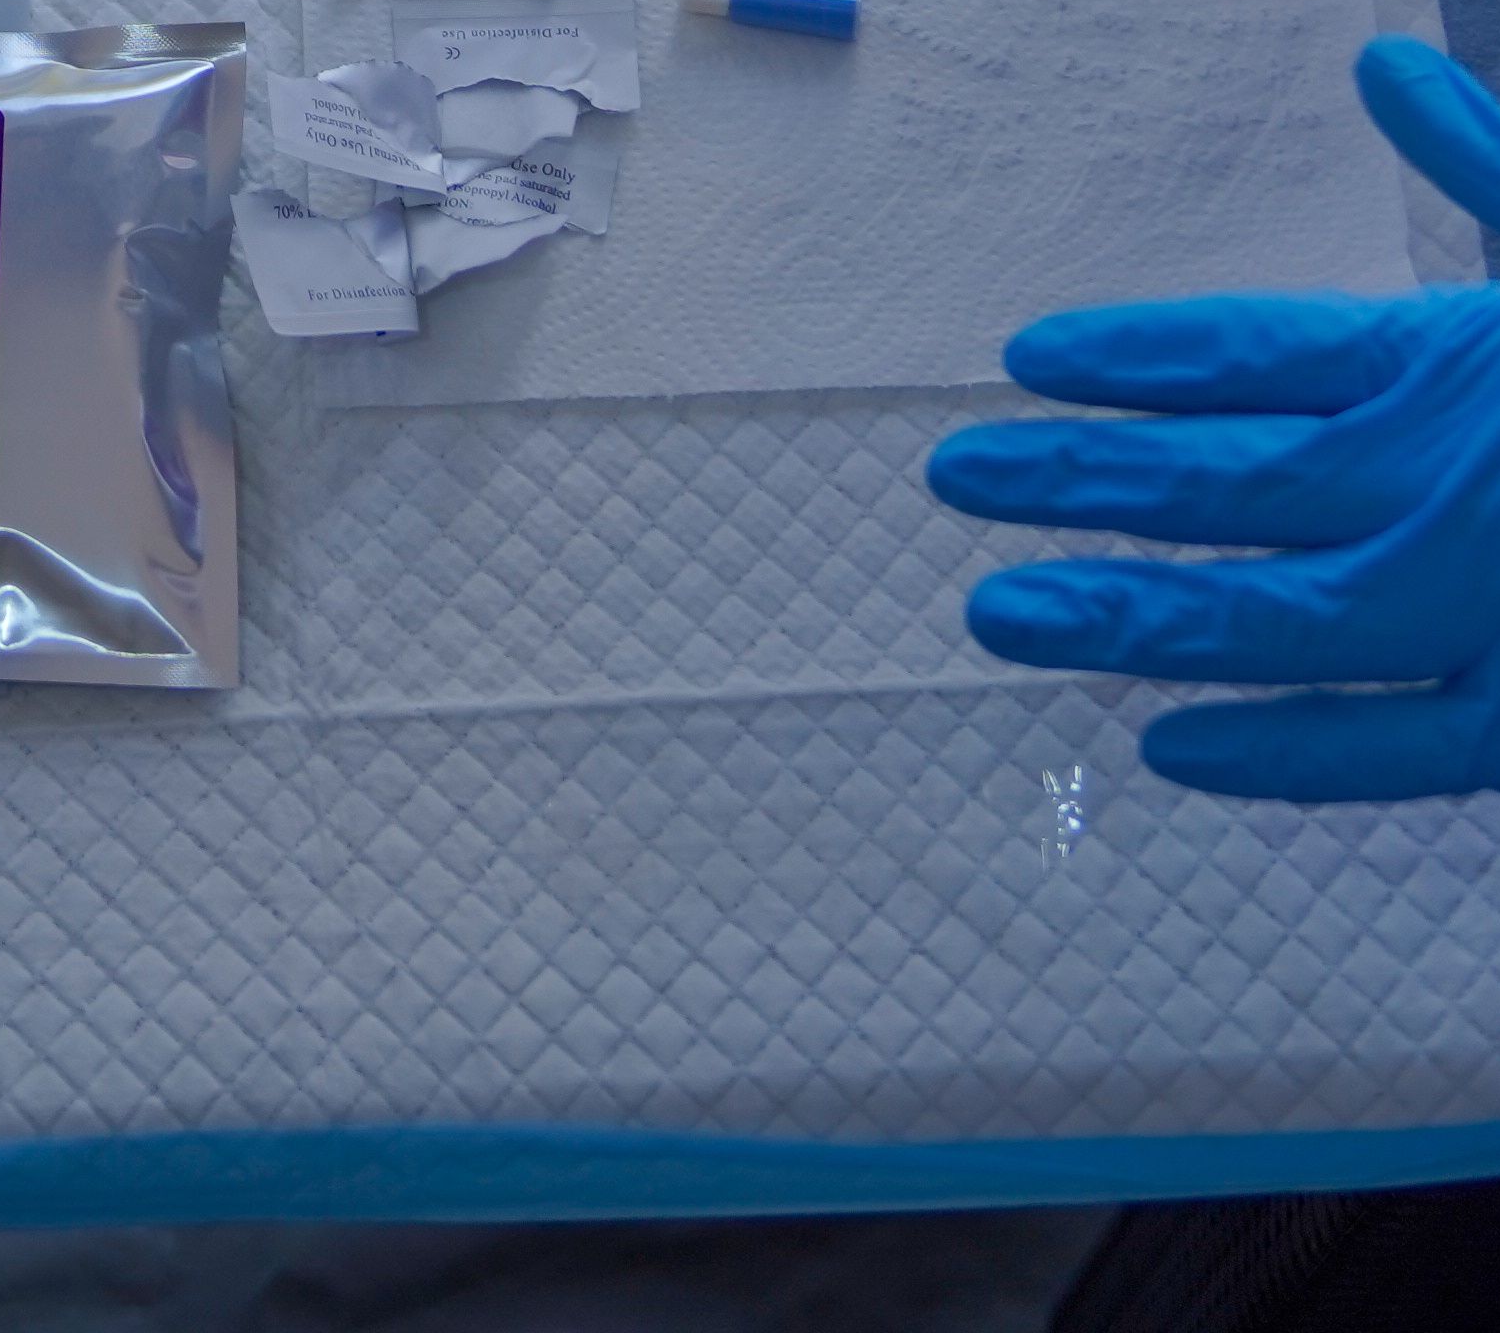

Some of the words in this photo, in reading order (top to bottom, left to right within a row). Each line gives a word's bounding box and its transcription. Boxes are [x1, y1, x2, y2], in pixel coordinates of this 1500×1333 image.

[440, 29, 466, 40] Use
[470, 27, 552, 40] Disinfection
[554, 26, 579, 38] For
[539, 159, 578, 185] Only
[307, 288, 329, 301] For
[330, 284, 408, 300] Disinfection
